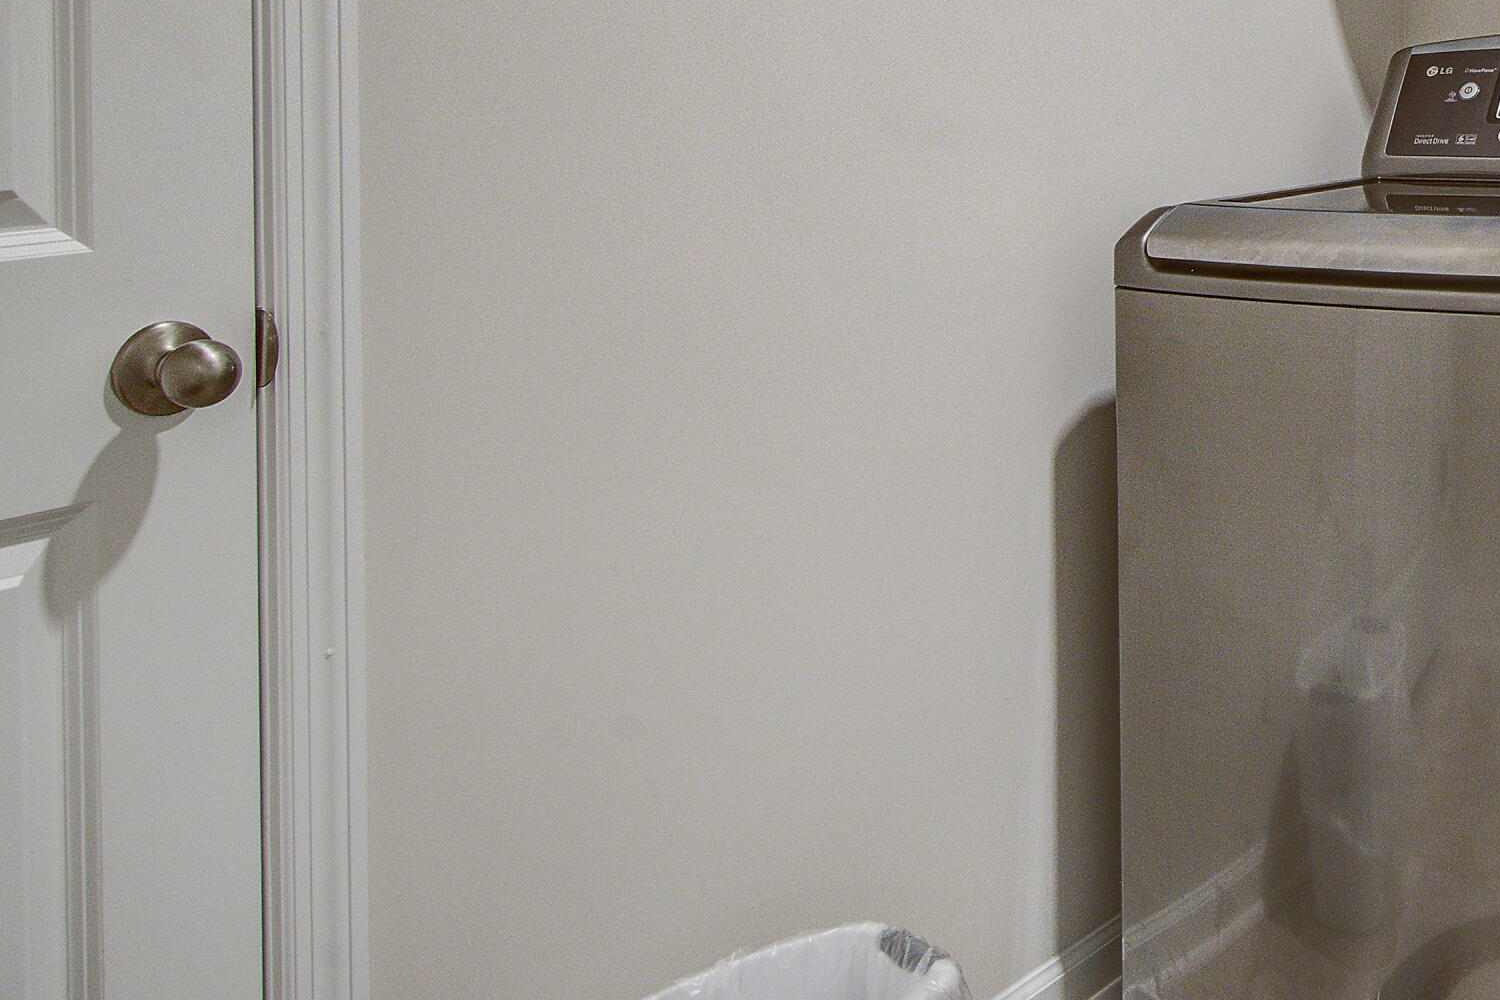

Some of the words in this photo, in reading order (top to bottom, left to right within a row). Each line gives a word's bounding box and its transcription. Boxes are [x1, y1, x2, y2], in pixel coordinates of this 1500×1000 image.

[1439, 67, 1454, 75] LG
[1413, 137, 1433, 145] Direct
[1433, 137, 1449, 145] Drive
